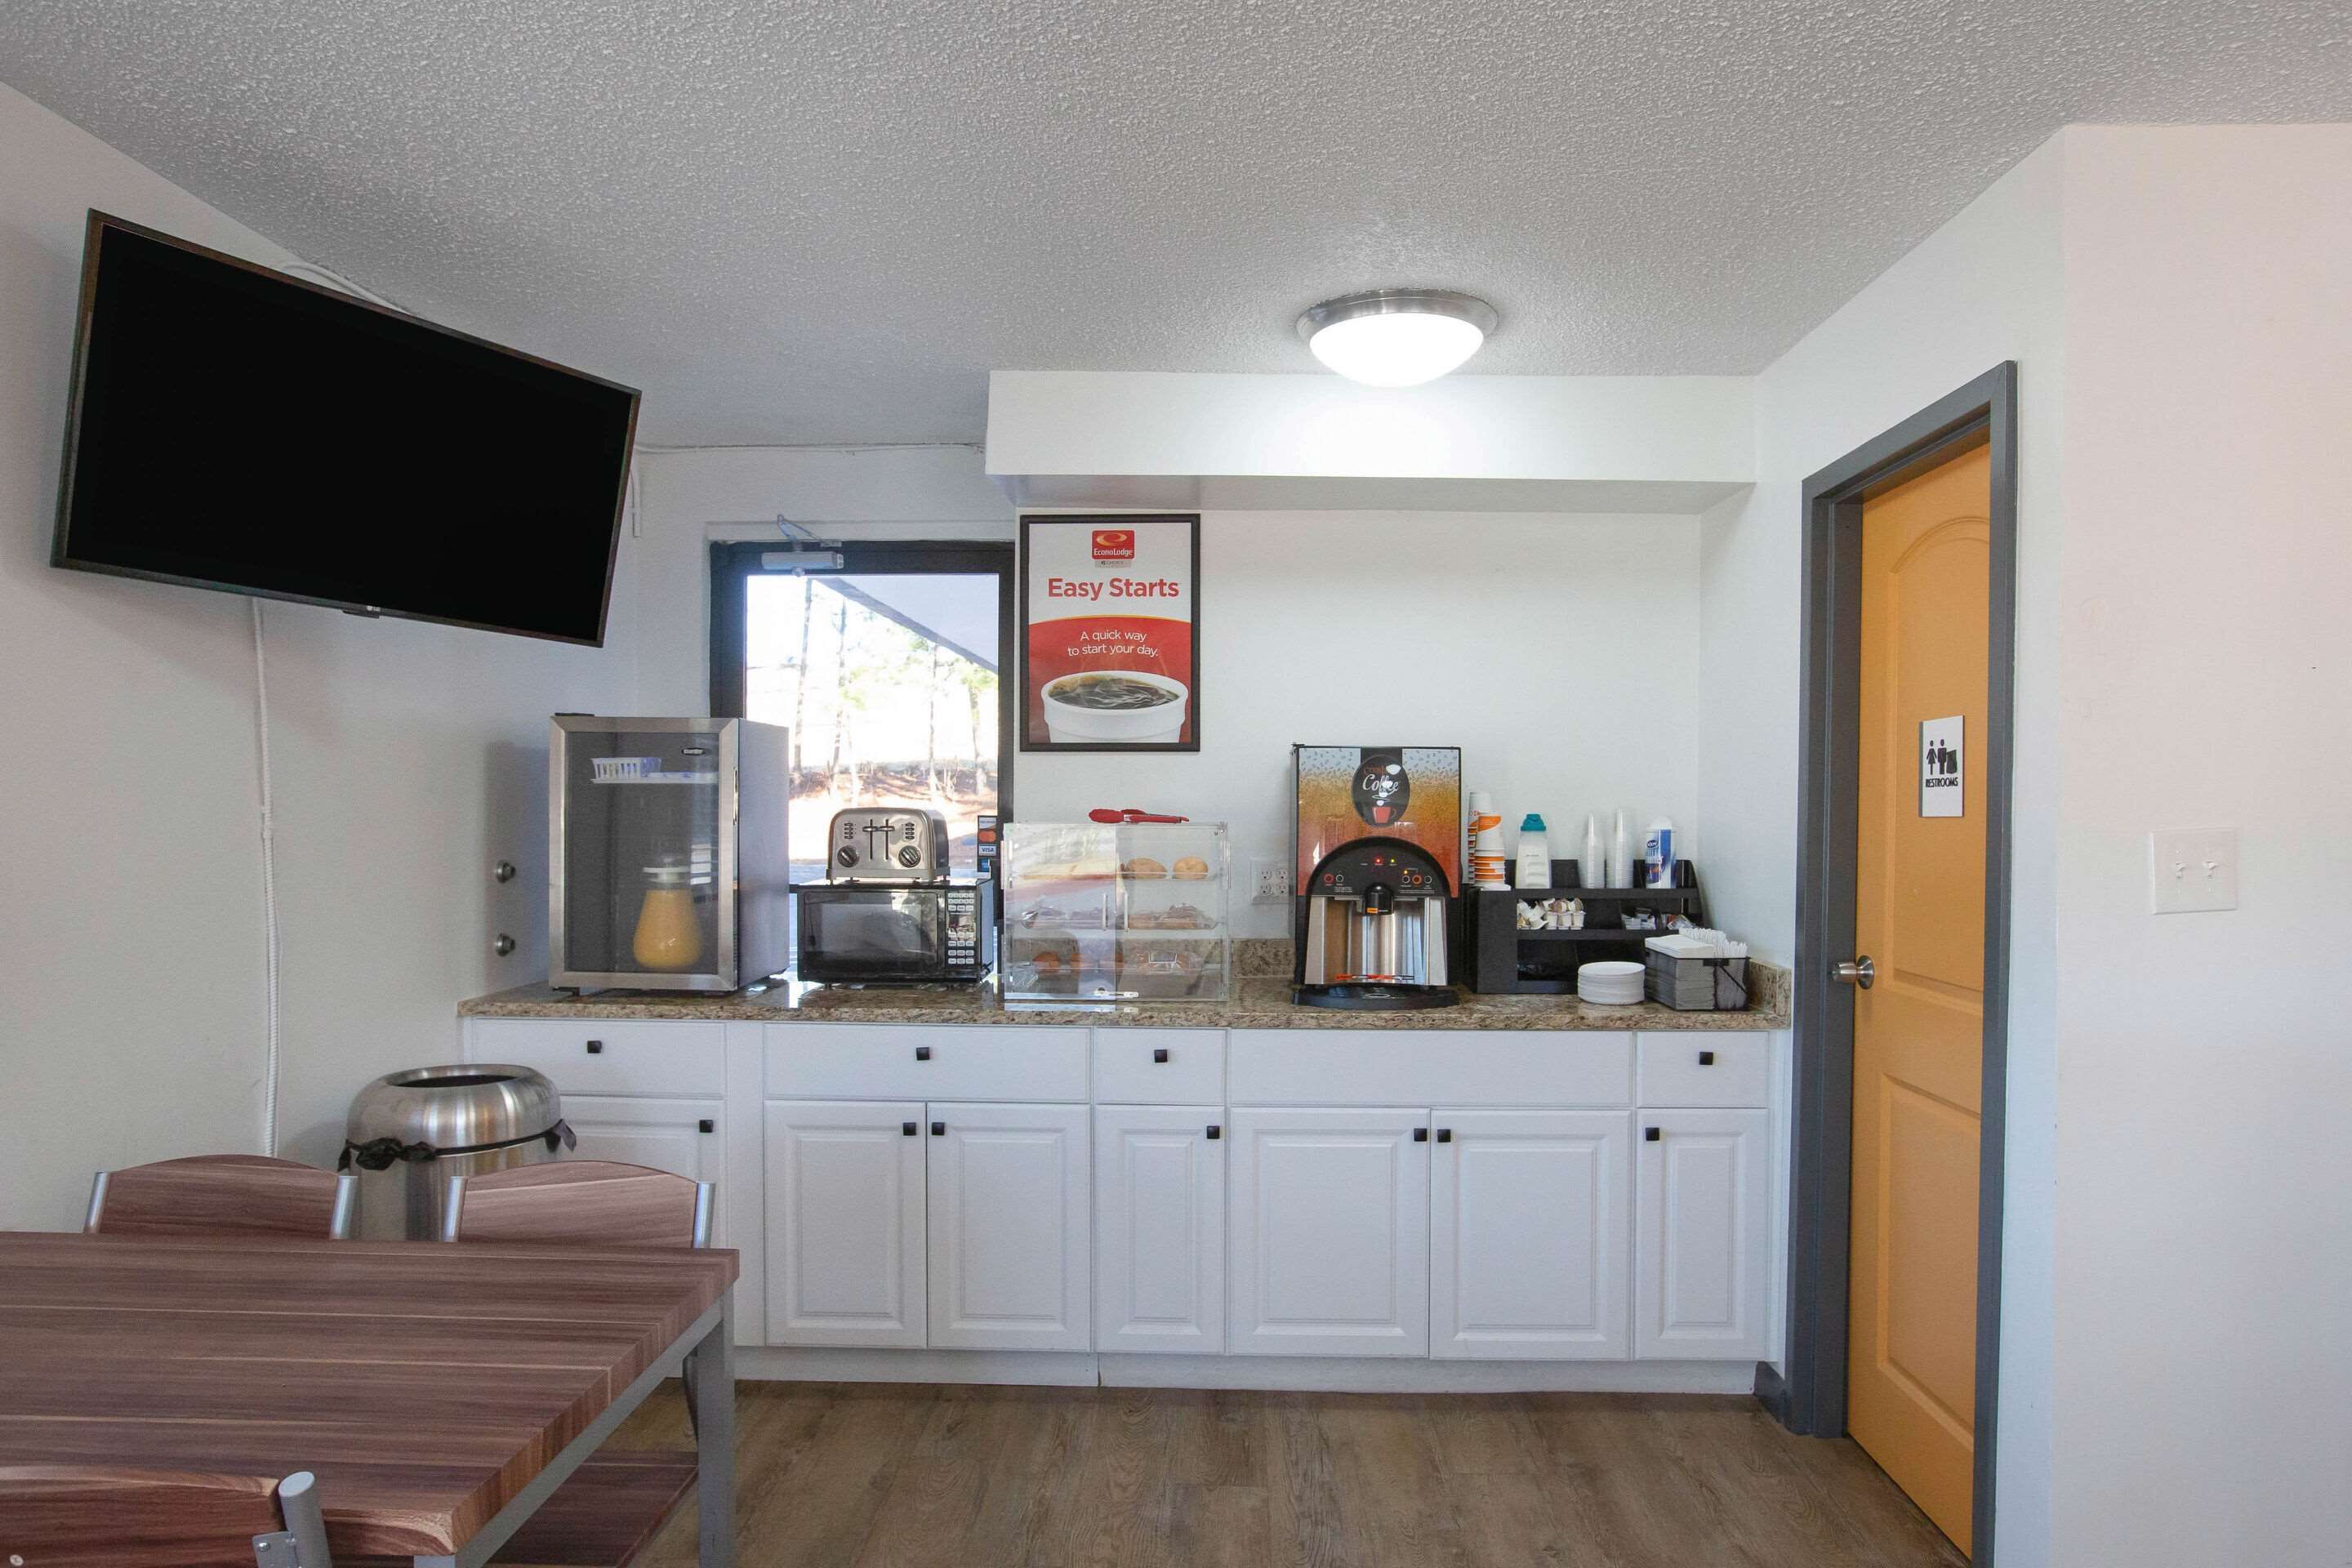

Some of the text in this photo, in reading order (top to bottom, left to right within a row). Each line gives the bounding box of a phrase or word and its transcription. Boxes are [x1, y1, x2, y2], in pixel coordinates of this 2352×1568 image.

[1094, 548, 1133, 557] EconoLodge
[1048, 577, 1179, 602] Easy Starts
[1080, 630, 1147, 643] A quick way
[1067, 644, 1158, 657] to start your day.
[1925, 777, 1958, 788] RESTROOMS
